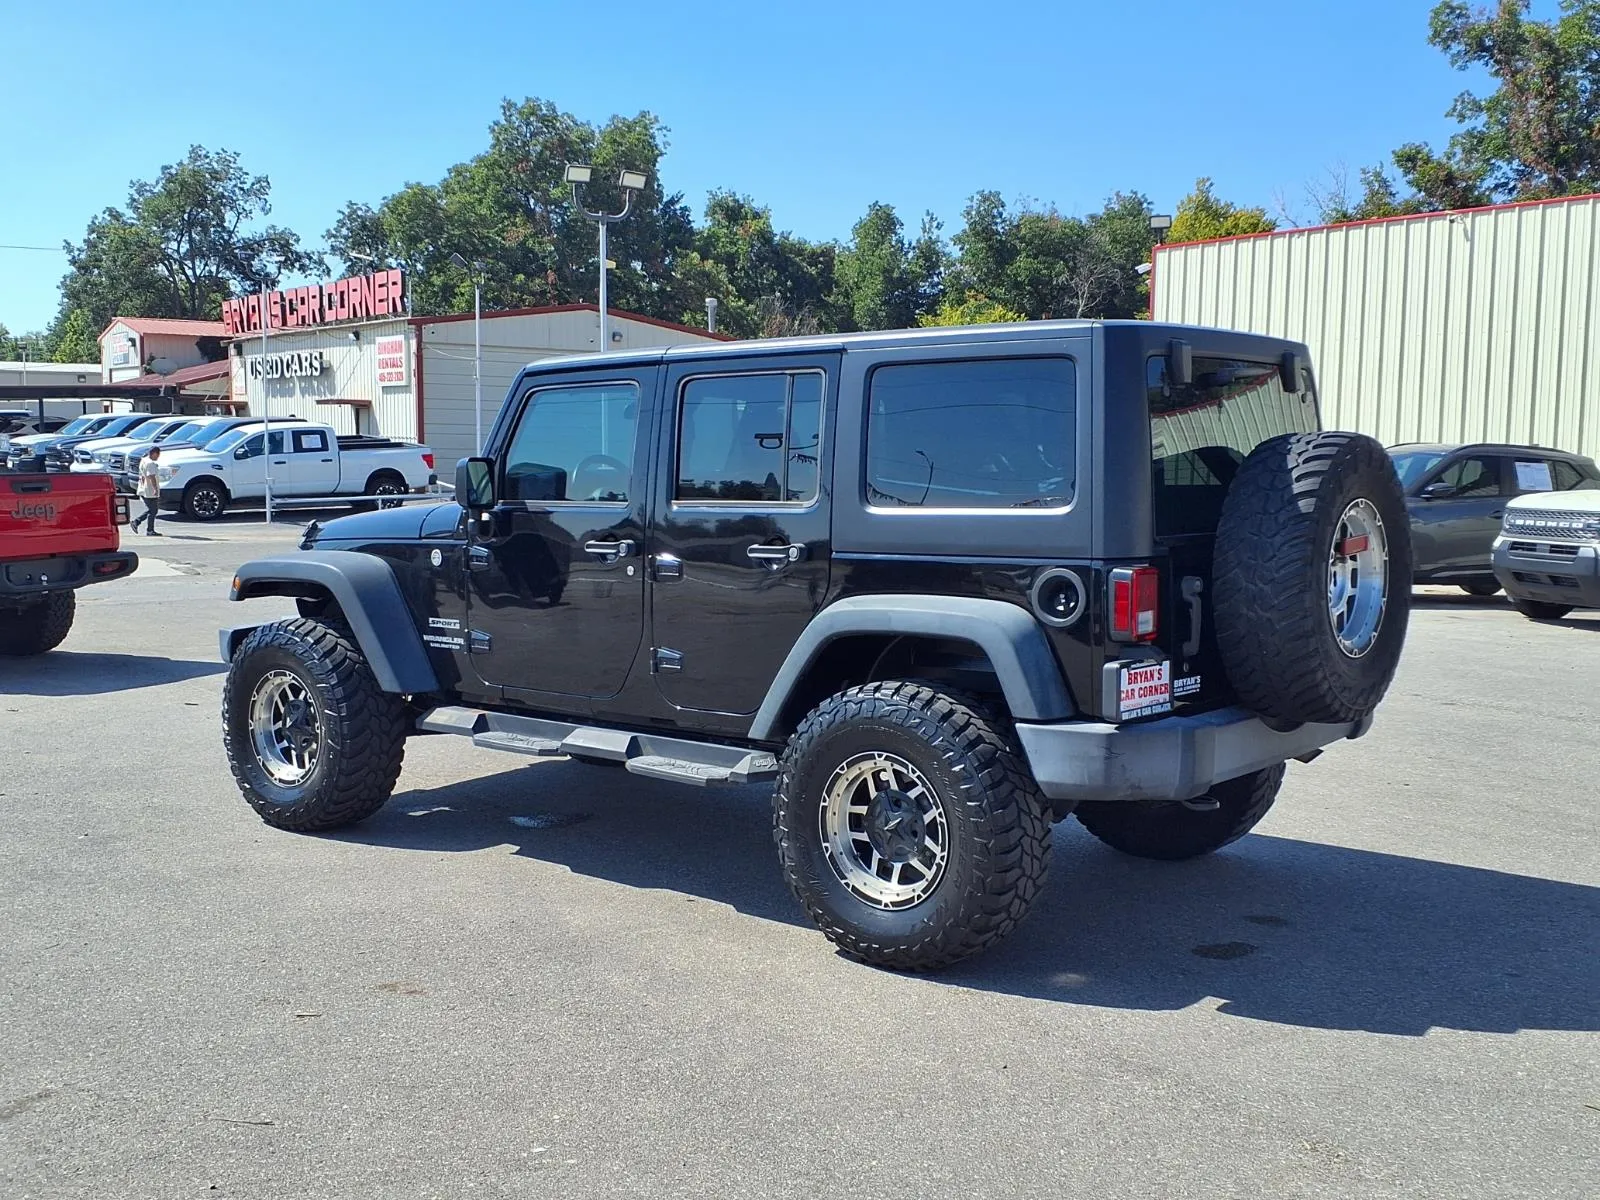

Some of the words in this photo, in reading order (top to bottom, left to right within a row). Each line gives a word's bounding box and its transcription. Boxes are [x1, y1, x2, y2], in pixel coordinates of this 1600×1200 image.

[285, 285, 320, 327] CAR
[323, 268, 403, 323] CORNER
[246, 355, 281, 380] USED
[283, 351, 321, 378] CARS
[378, 357, 403, 369] RENTALS
[11, 501, 57, 520] Jeep
[1515, 519, 1584, 529] BRONCO
[430, 618, 460, 628] SPORT
[423, 634, 465, 645] WRANGLER
[430, 642, 460, 650] UNLIMITED
[1127, 668, 1163, 686] BRYAN'S
[1174, 675, 1201, 688] BRYAN'S
[1121, 688, 1136, 702] CAR
[1138, 683, 1169, 698] CORNER
